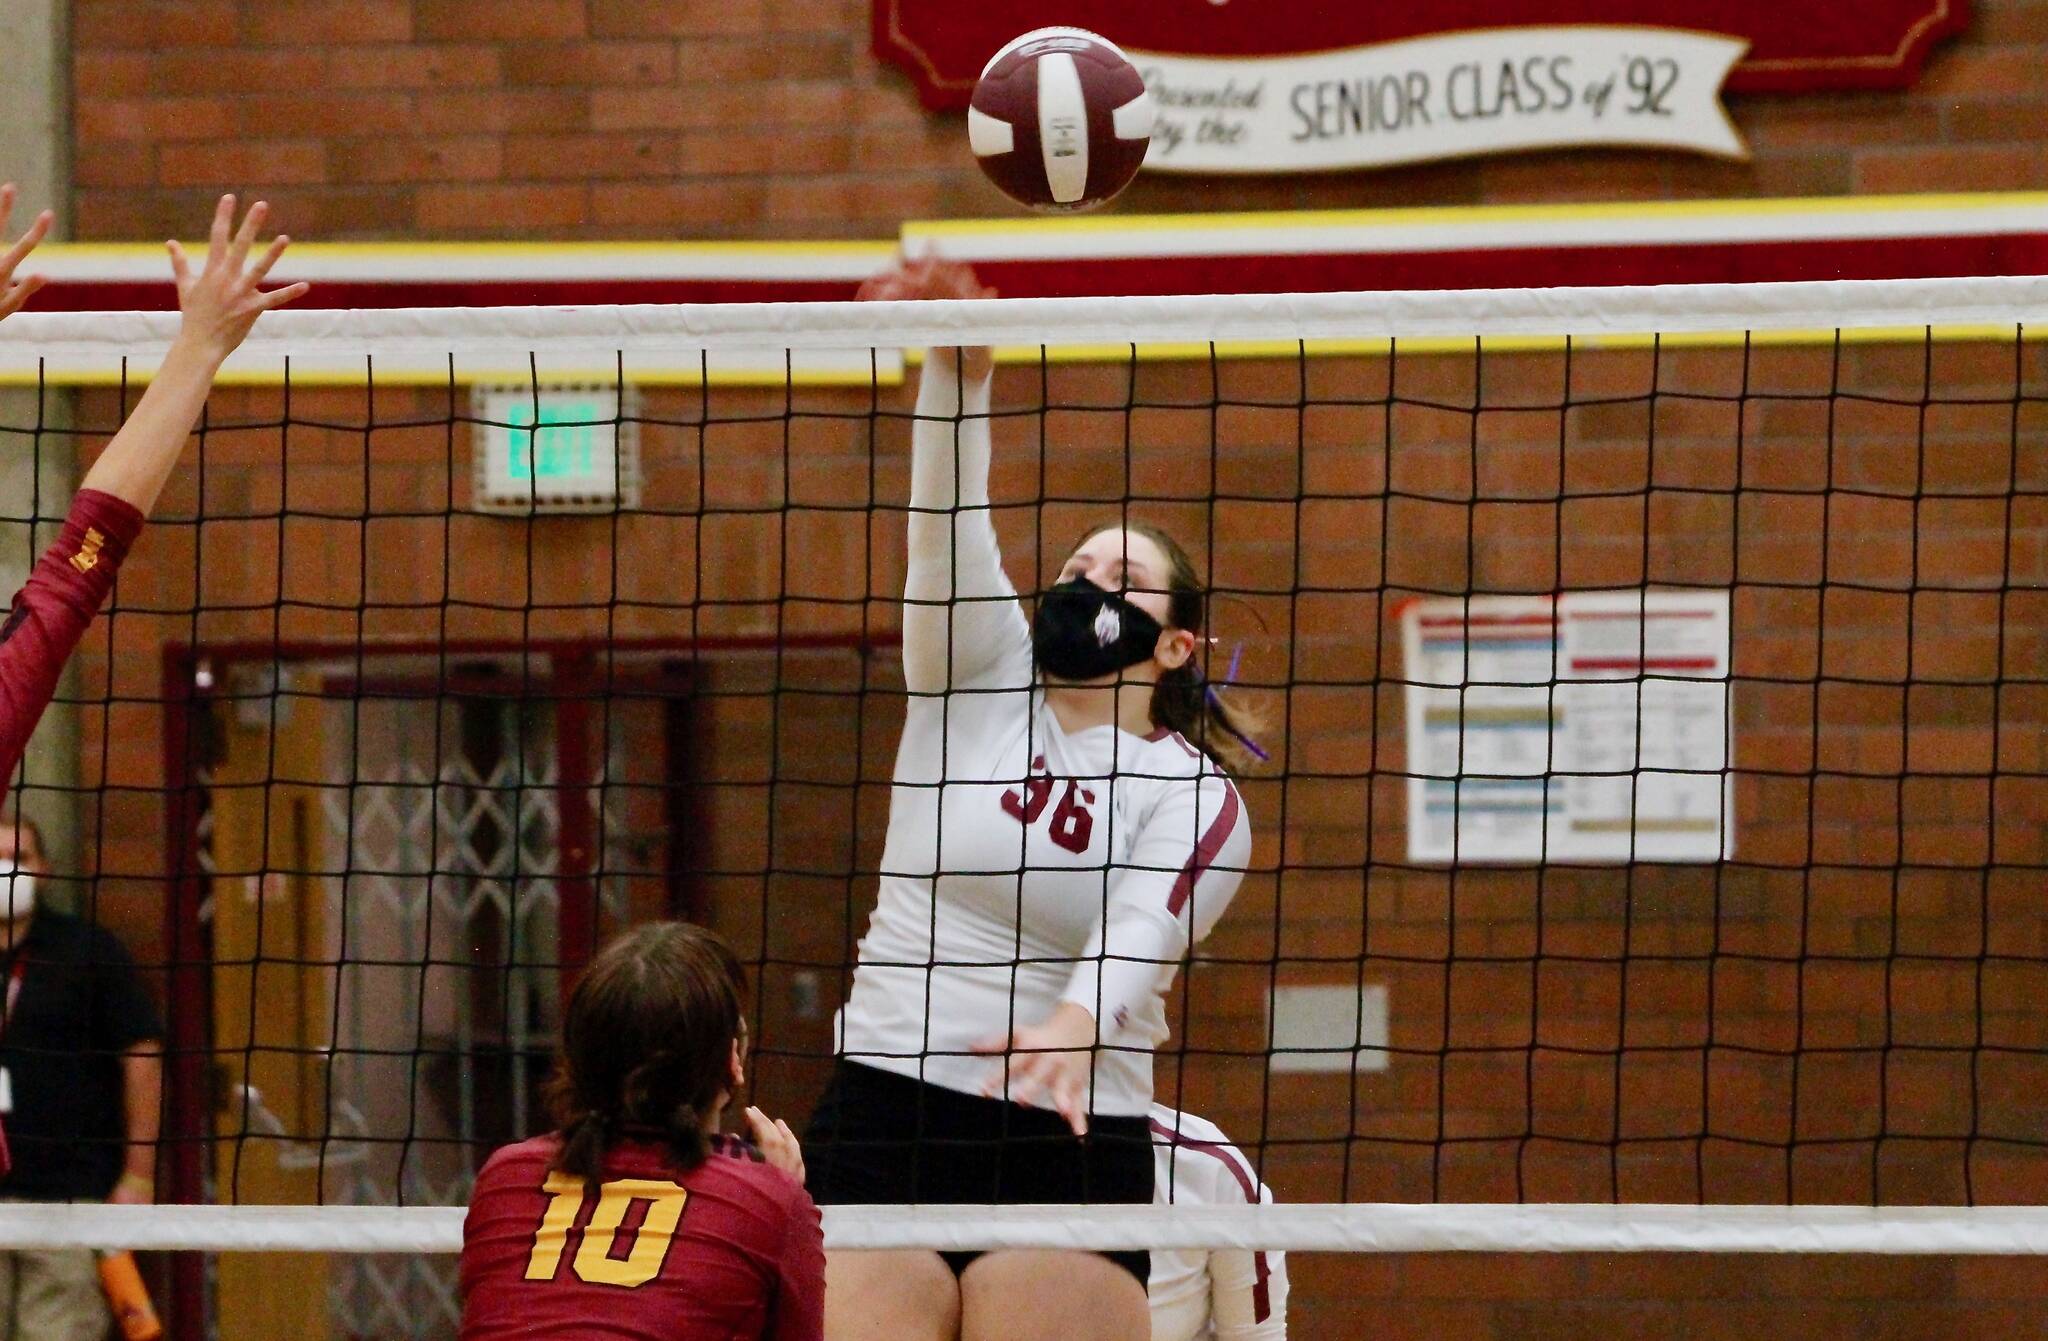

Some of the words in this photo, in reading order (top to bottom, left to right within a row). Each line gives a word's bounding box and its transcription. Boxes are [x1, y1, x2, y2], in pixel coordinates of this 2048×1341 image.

[1289, 69, 1432, 143] SENIOR
[1446, 55, 1574, 122] CLASS
[1582, 71, 1618, 118] of
[523, 1170, 688, 1288] 10
